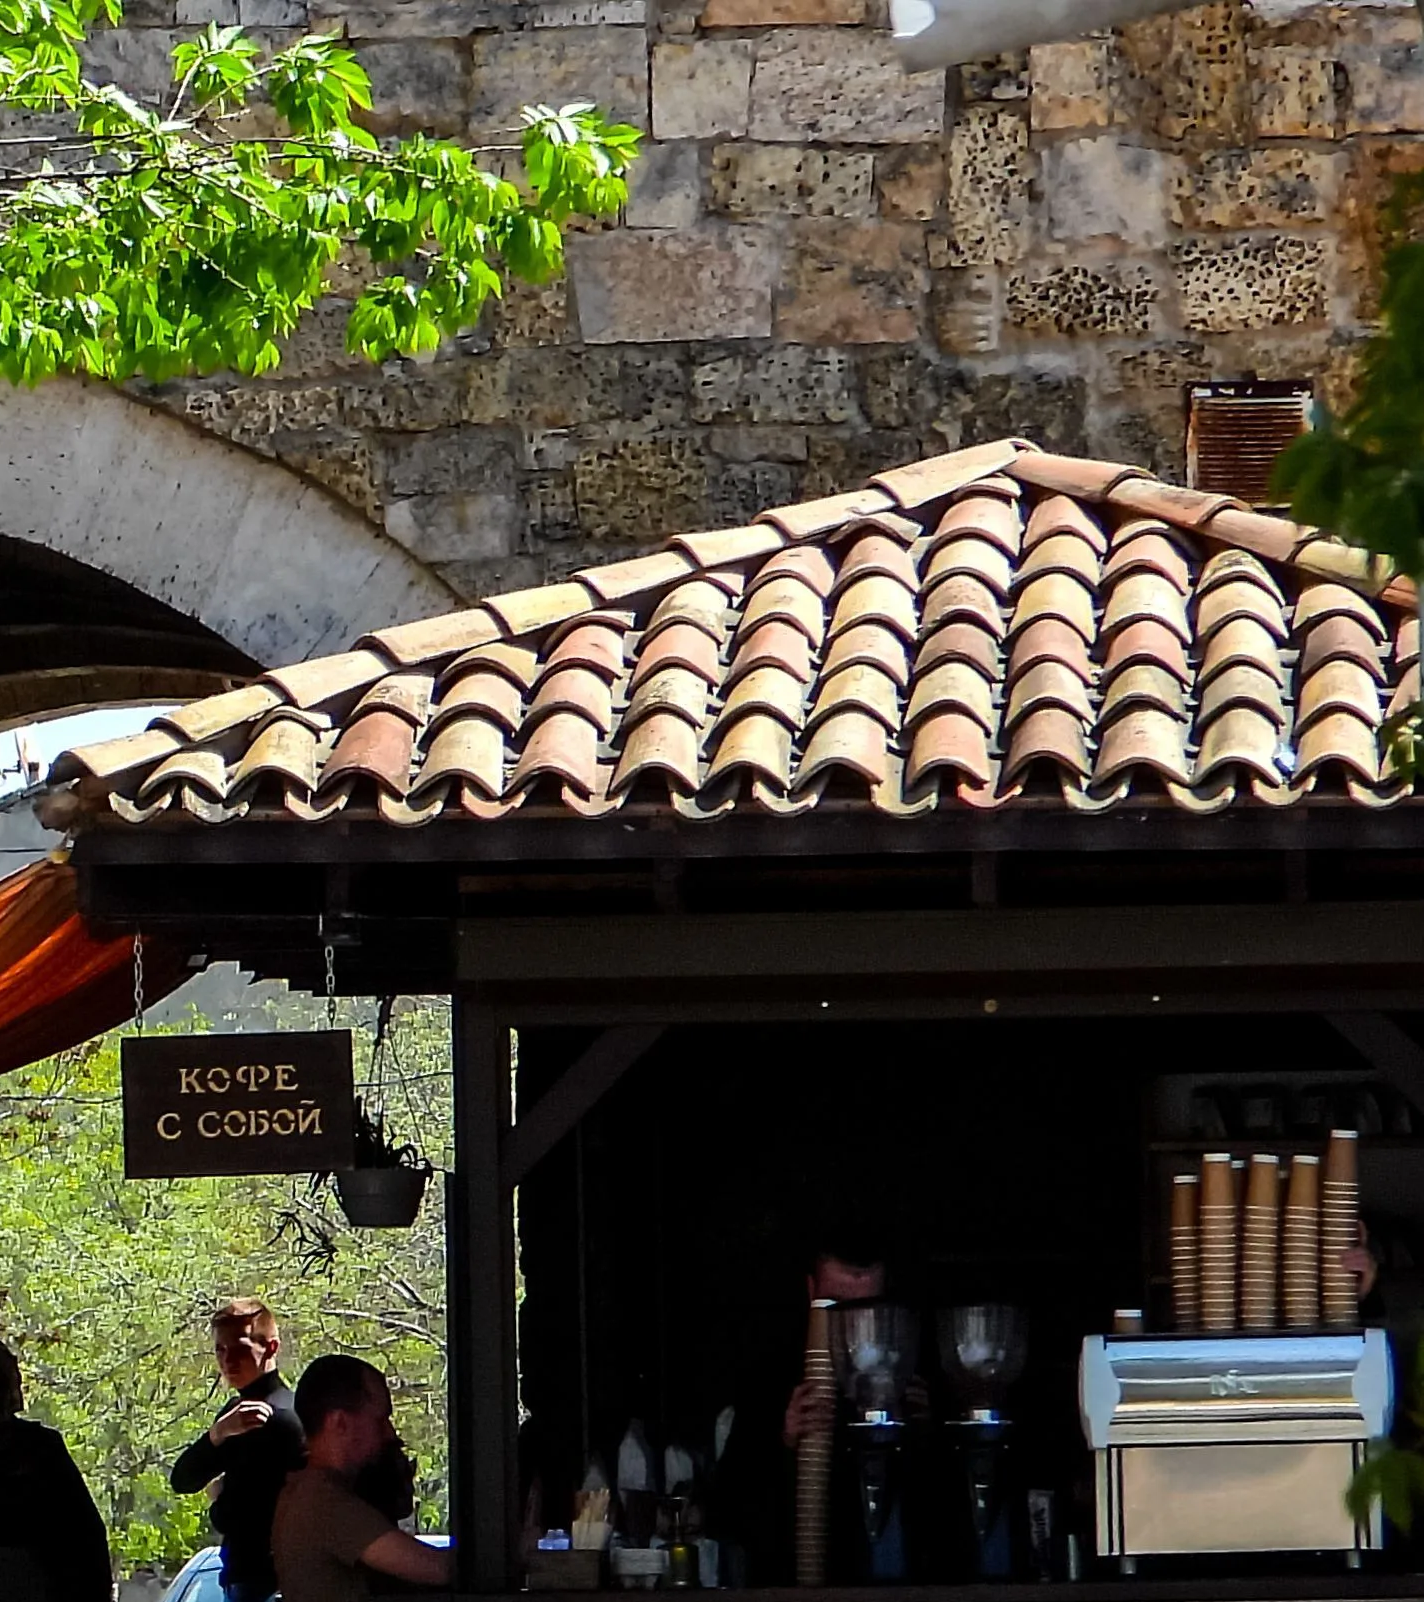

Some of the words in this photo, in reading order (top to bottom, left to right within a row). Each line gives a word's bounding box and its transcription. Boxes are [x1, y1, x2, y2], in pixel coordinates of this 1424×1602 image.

[179, 1064, 299, 1094] КОФЕ
[156, 1113, 182, 1140] С
[197, 1100, 323, 1138] СОБОЙ
